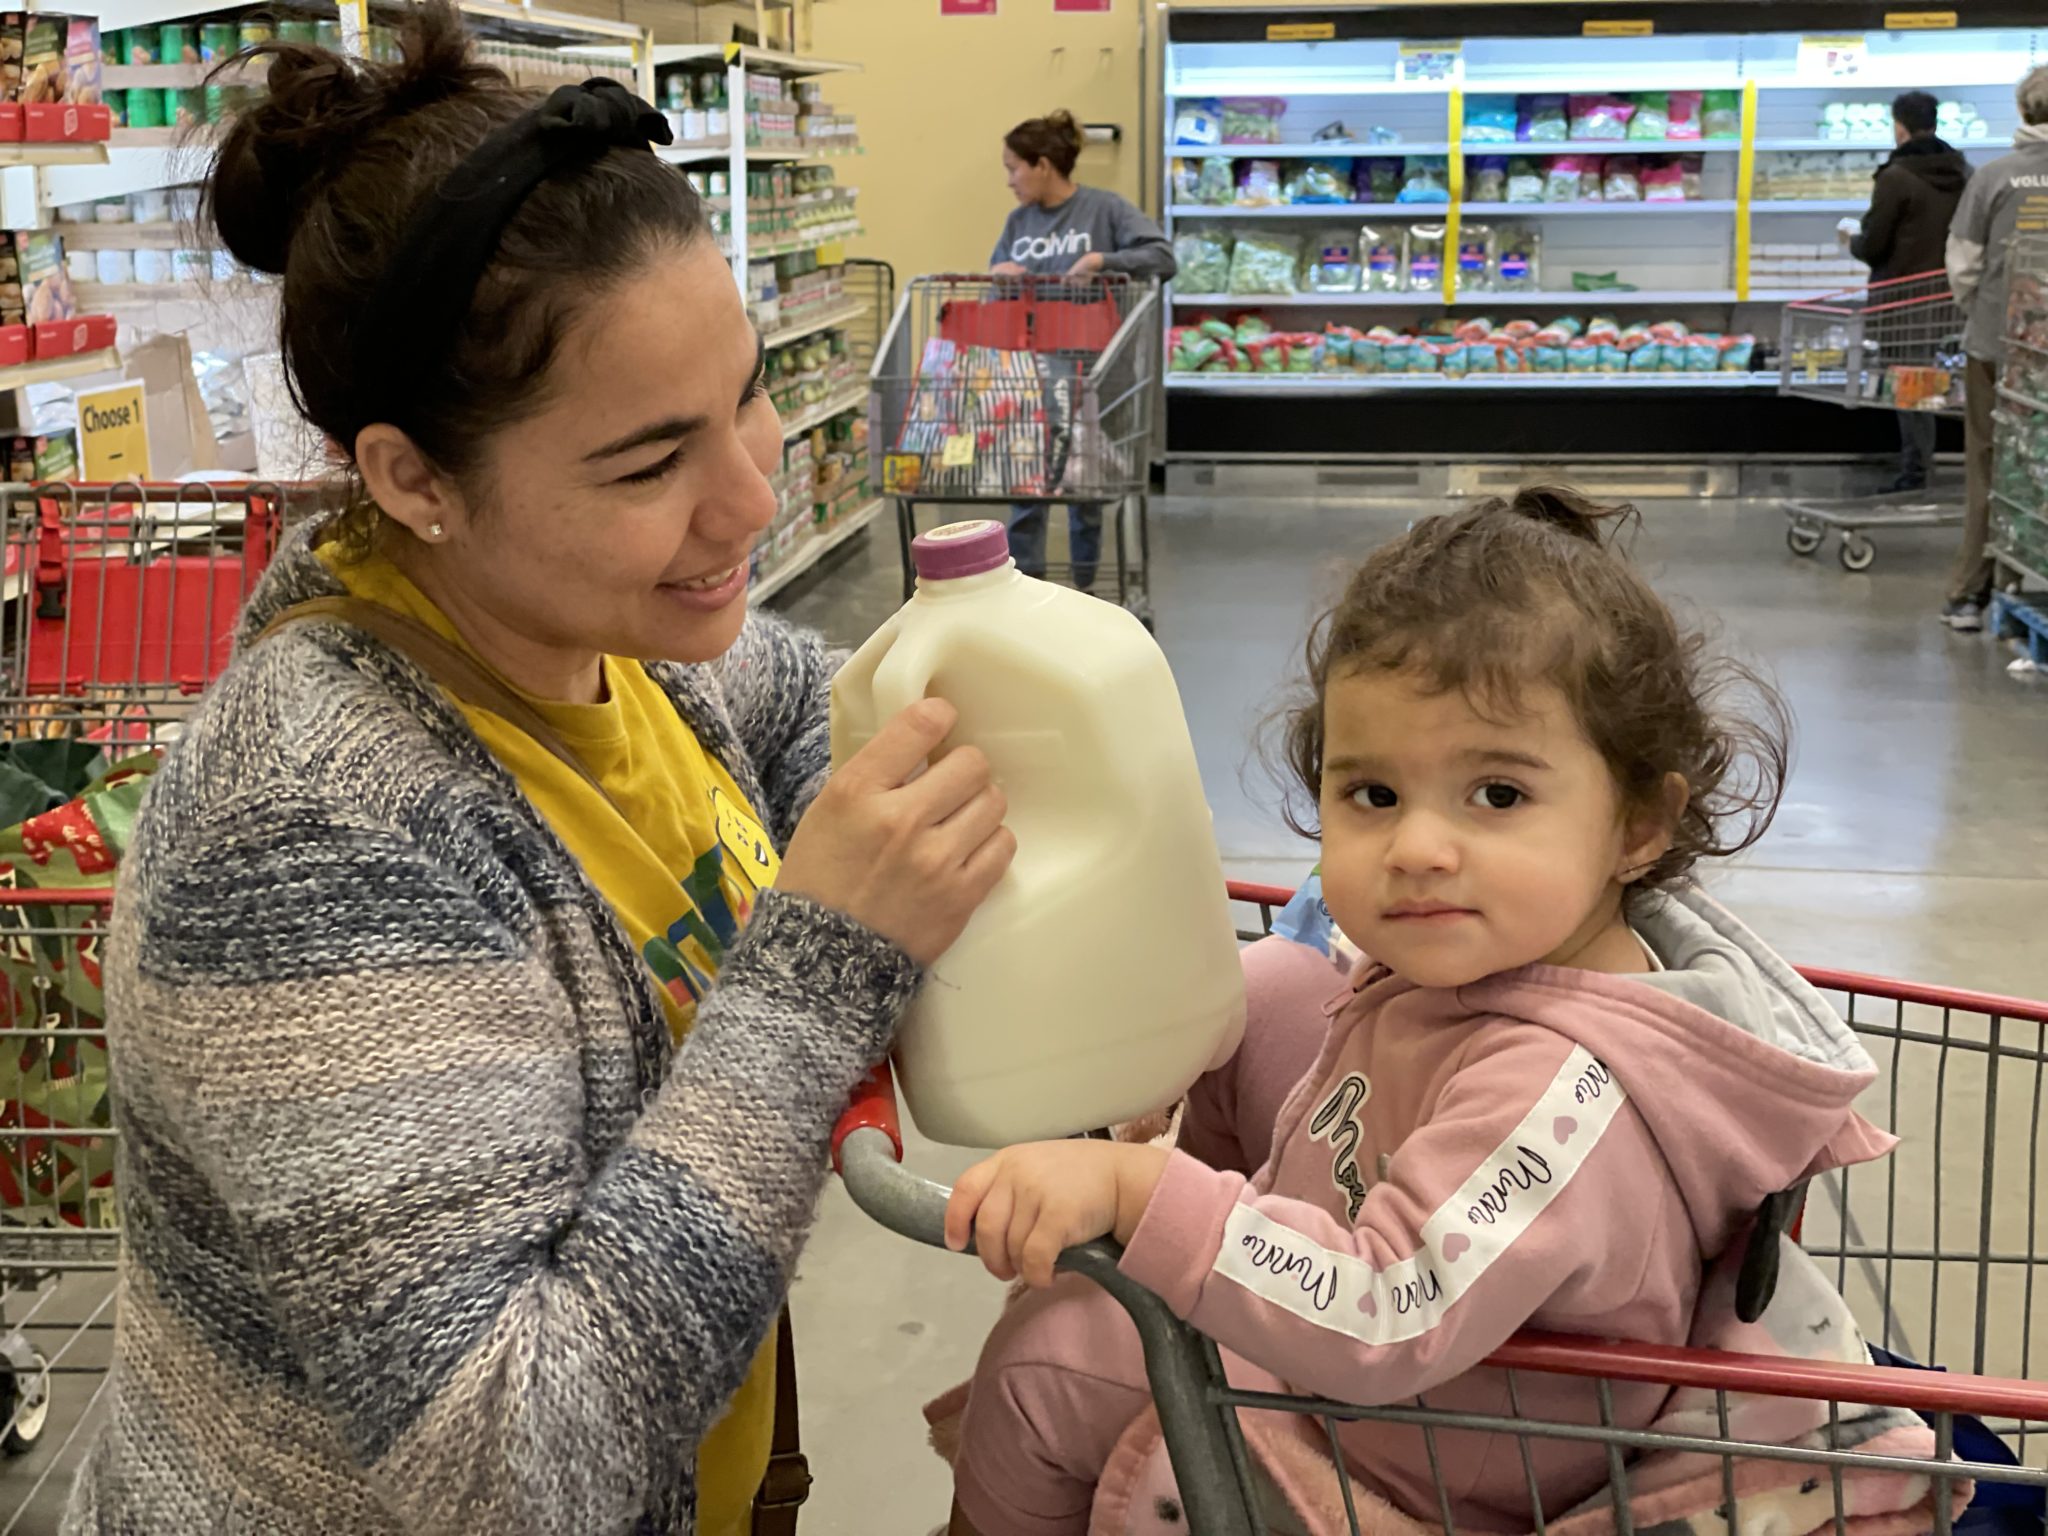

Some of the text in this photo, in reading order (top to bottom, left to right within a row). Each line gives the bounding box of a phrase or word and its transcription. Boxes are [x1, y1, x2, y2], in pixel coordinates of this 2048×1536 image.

[83, 397, 140, 433] Choose 1
[1467, 1144, 1553, 1225] Minnie
[1242, 1234, 1338, 1311] Minnie
